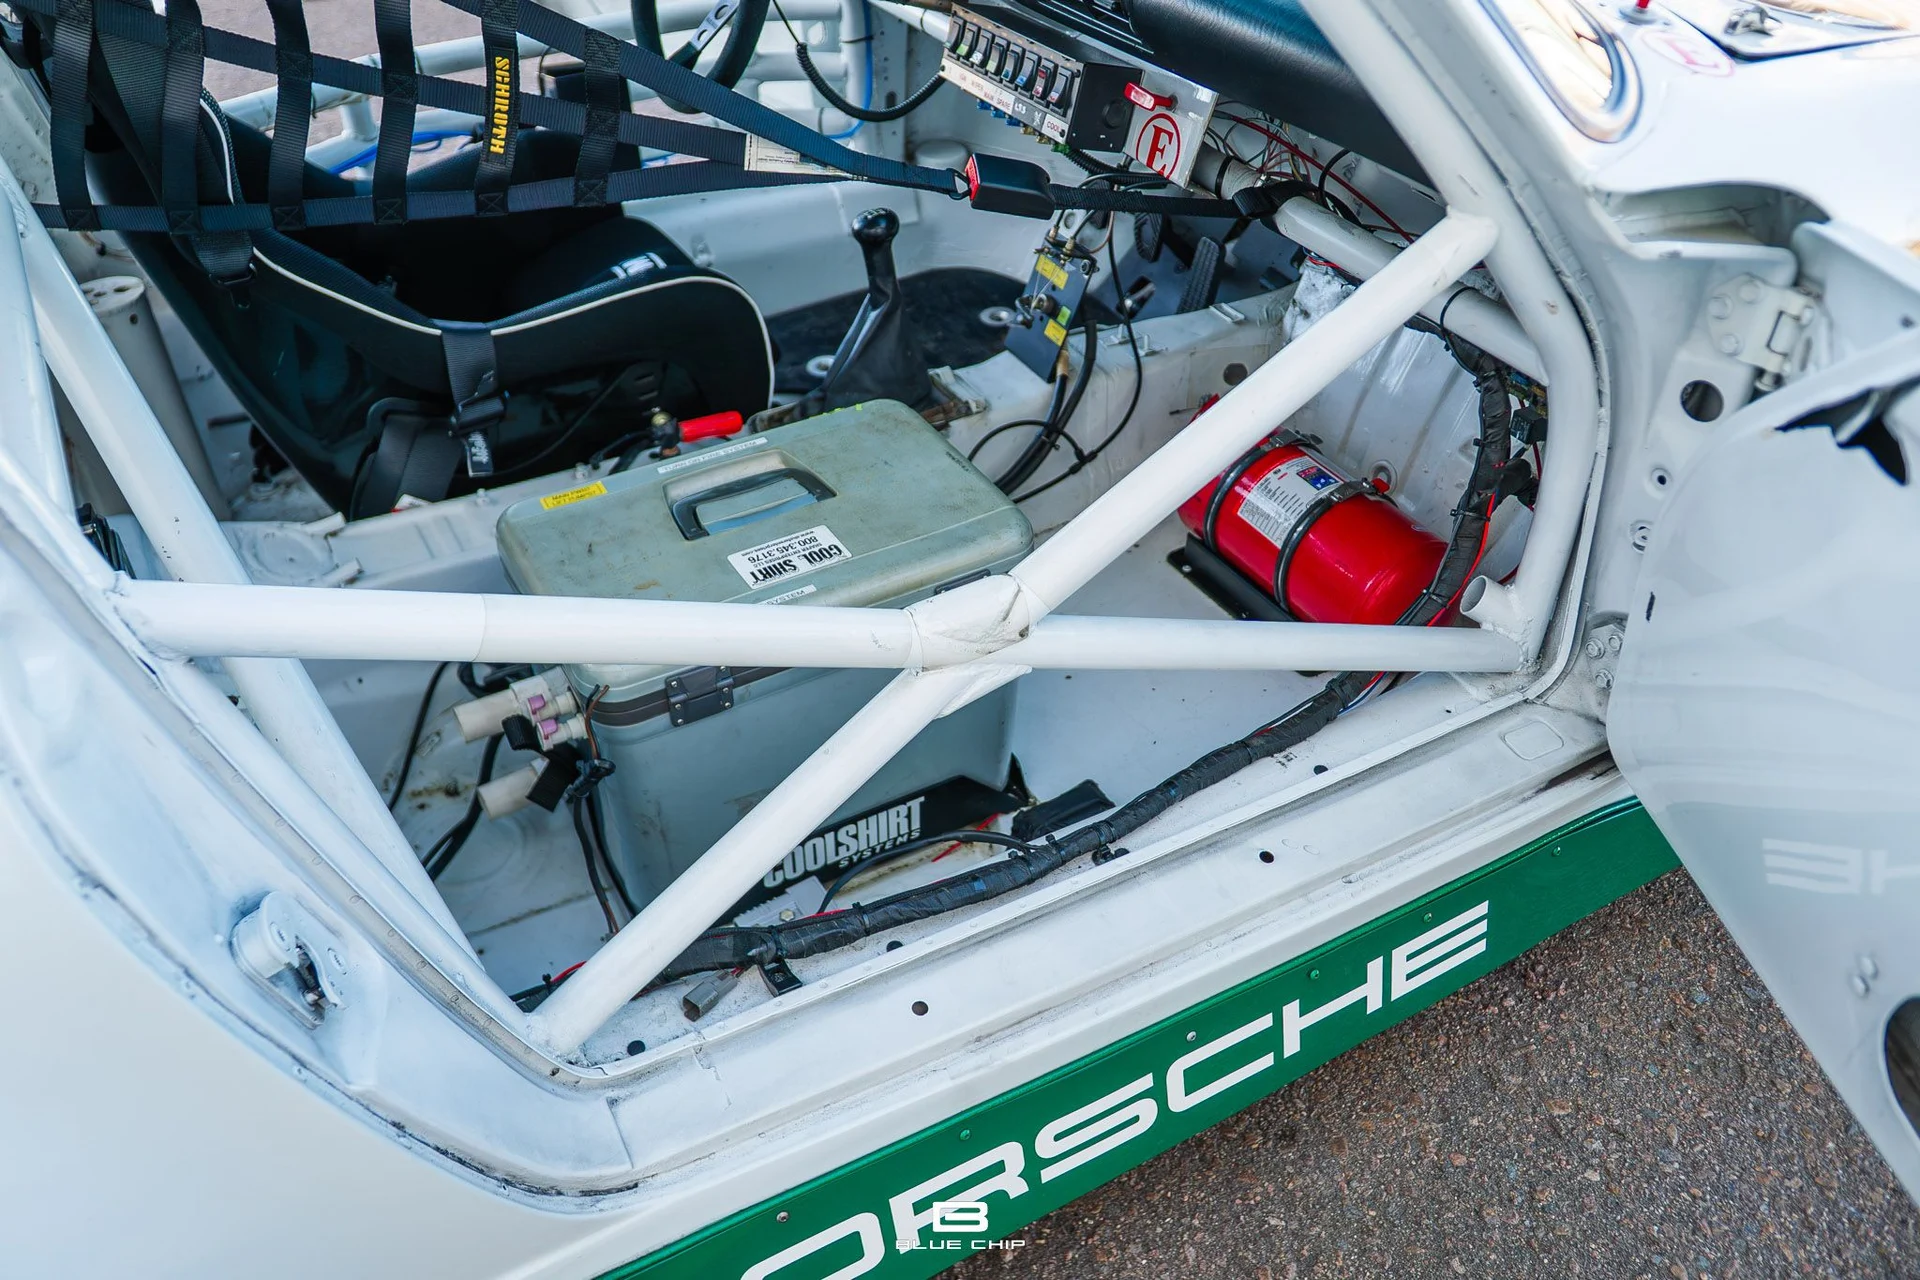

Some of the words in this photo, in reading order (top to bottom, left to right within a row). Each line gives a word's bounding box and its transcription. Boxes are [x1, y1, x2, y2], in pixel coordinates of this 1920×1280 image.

[489, 56, 510, 155] SCHROTH
[1145, 124, 1175, 176] E
[747, 535, 818, 564] 800.345.3176
[752, 560, 764, 568] LLC
[801, 544, 843, 566] COOL
[750, 559, 798, 584] SHIRT
[839, 828, 921, 868] SYSTEMS
